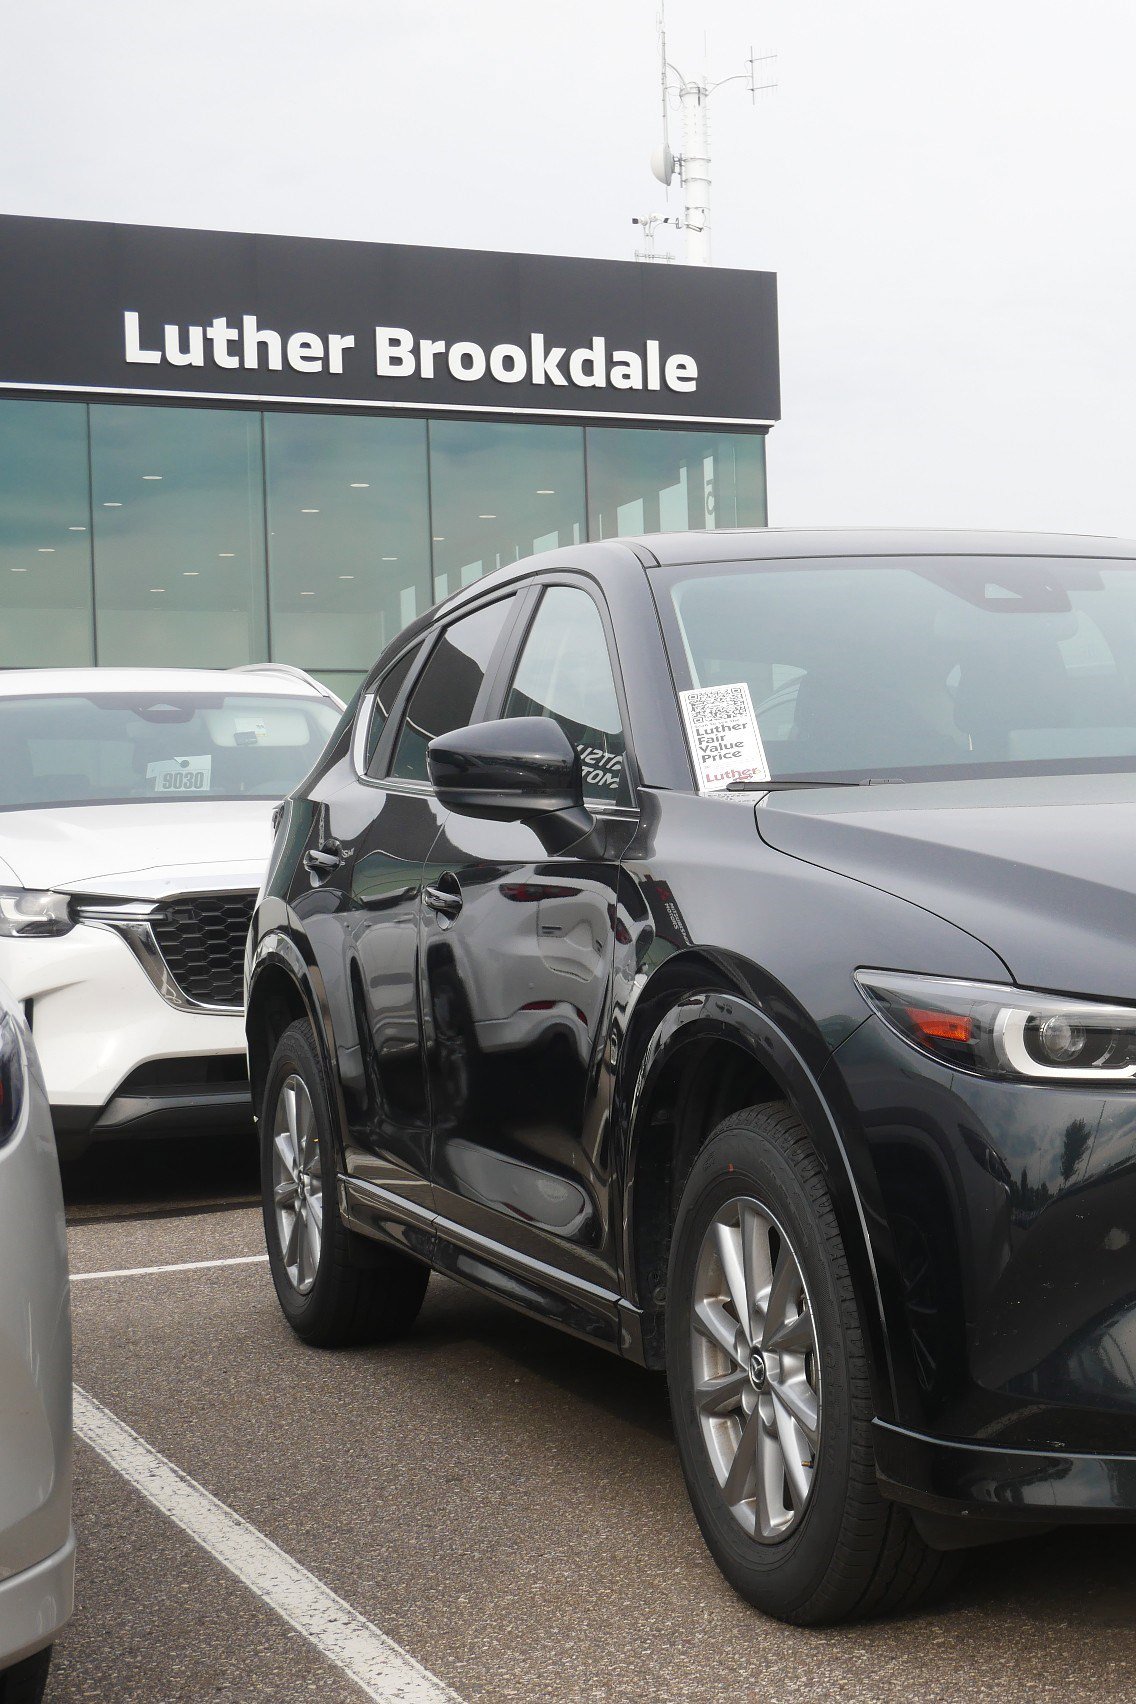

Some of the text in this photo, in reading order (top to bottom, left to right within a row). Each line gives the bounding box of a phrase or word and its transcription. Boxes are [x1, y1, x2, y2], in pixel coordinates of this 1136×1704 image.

[123, 311, 698, 393] Luther Brookdale
[695, 723, 748, 737] Luther
[697, 734, 726, 746] Fair
[699, 741, 744, 753] Value
[701, 750, 742, 763] Price
[162, 772, 204, 789] 9030
[705, 767, 758, 783] Luther
